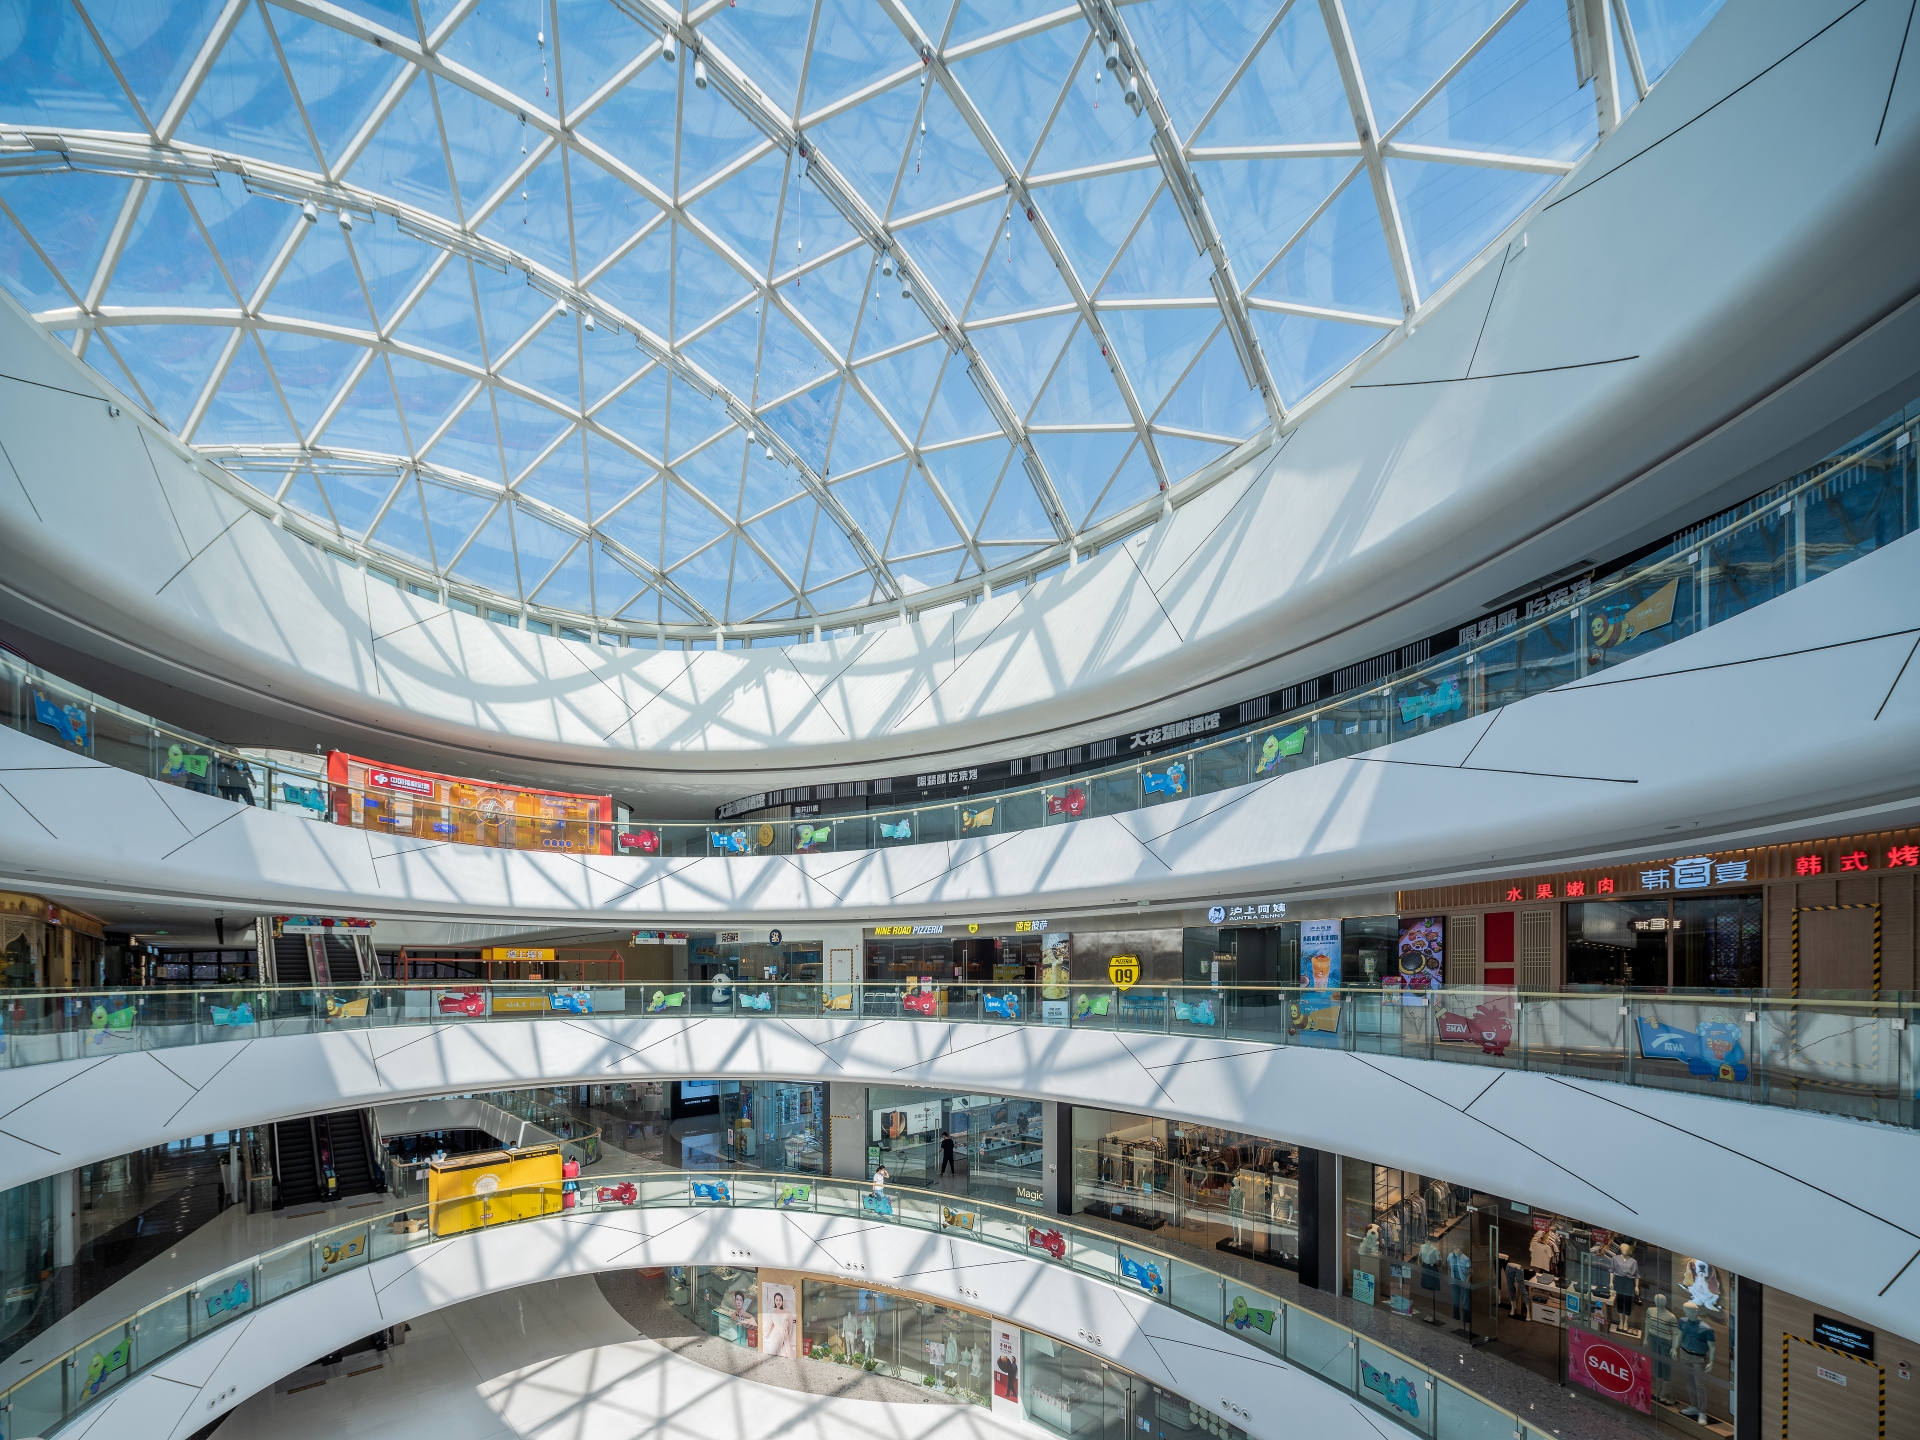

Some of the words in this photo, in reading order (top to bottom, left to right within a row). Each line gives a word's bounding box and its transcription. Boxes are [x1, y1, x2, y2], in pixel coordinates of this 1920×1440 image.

[1130, 712, 1221, 749] 大花精酿酒馆
[1795, 844, 1920, 876] 韩式烤
[1506, 877, 1614, 902] 水果嫩肉
[1229, 902, 1286, 916] 沪上阿姨
[874, 926, 891, 935] NINE
[892, 926, 912, 935] ROAD
[912, 925, 944, 934] PIZZERIA
[1015, 919, 1048, 933] 速度披萨
[1114, 968, 1133, 983] 09
[1588, 1355, 1630, 1382] SALE
